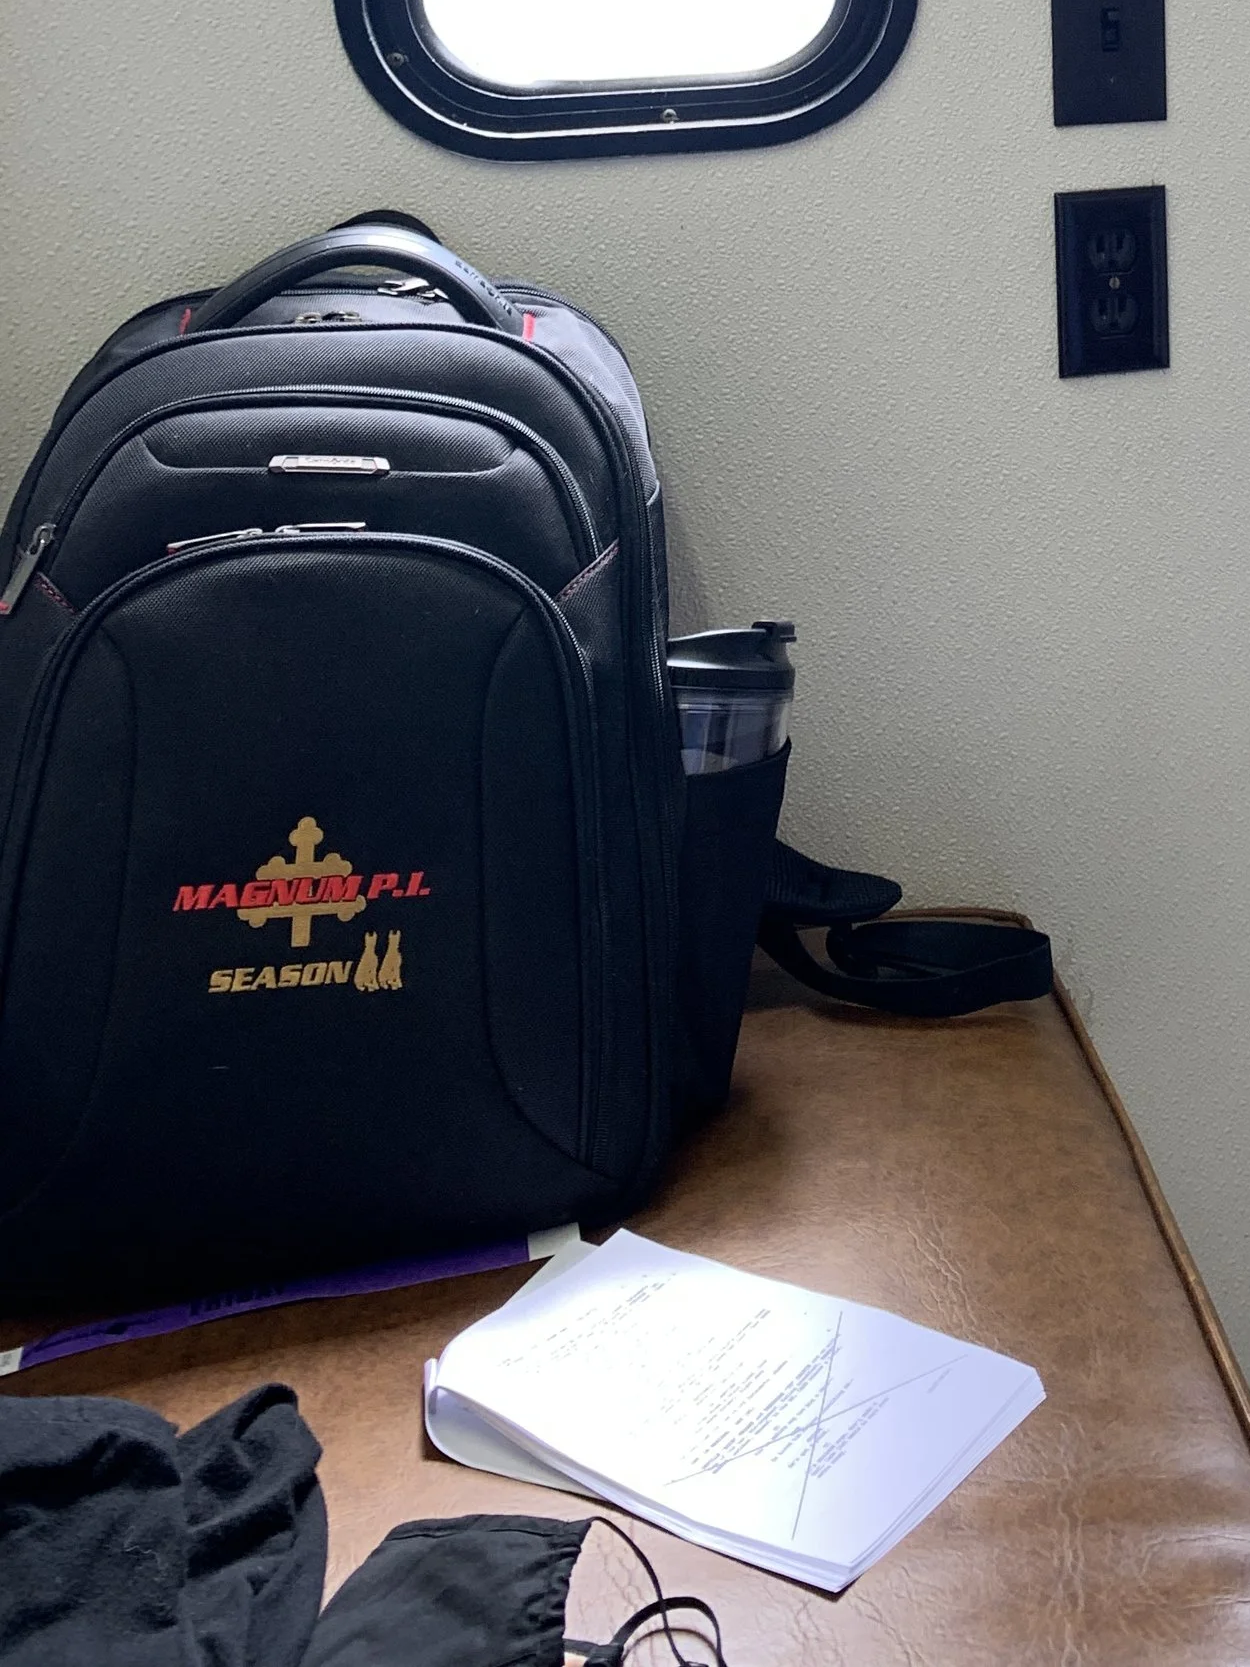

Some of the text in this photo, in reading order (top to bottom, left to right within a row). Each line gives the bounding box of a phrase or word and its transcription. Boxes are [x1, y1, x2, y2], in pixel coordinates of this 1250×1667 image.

[173, 871, 432, 912] MAGNUM P.I.
[208, 961, 353, 993] SEASON
